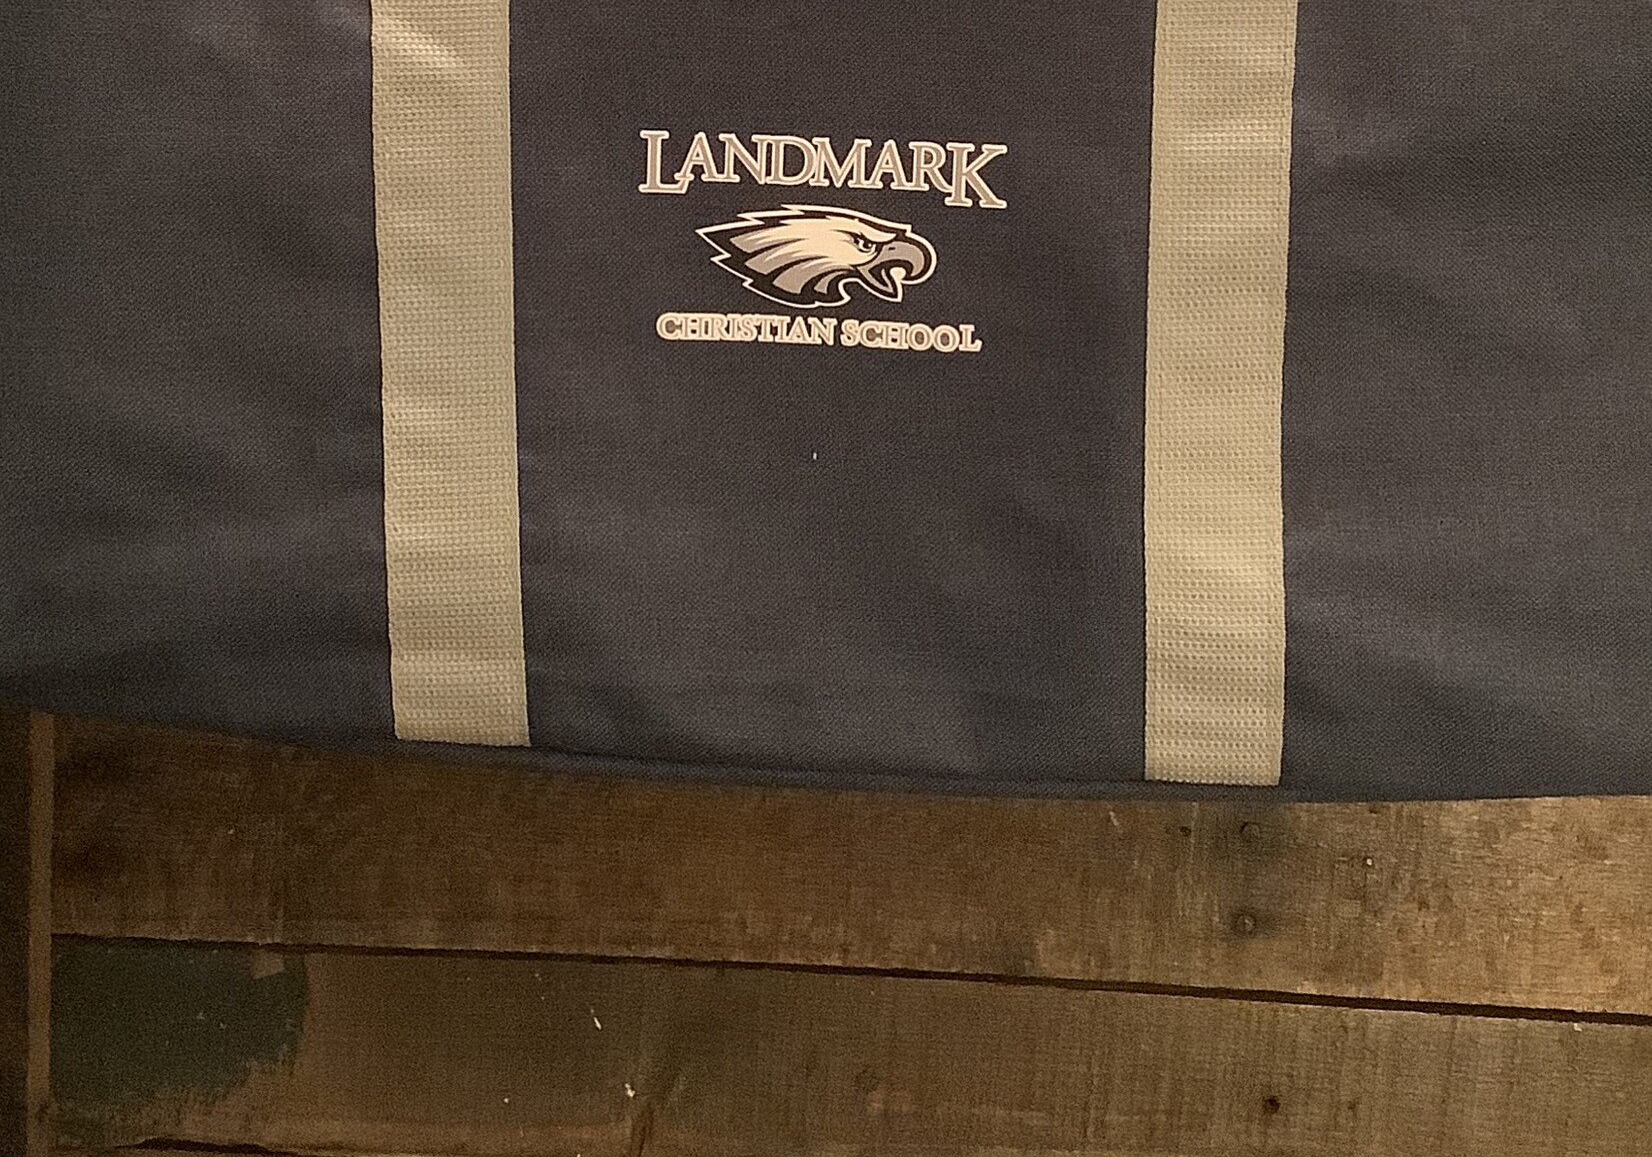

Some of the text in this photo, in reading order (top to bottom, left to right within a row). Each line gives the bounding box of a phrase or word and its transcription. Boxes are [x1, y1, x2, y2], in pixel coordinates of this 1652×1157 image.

[638, 129, 1008, 209] LANDMARK
[656, 312, 983, 352] CHRISTIAN SCHOOL
